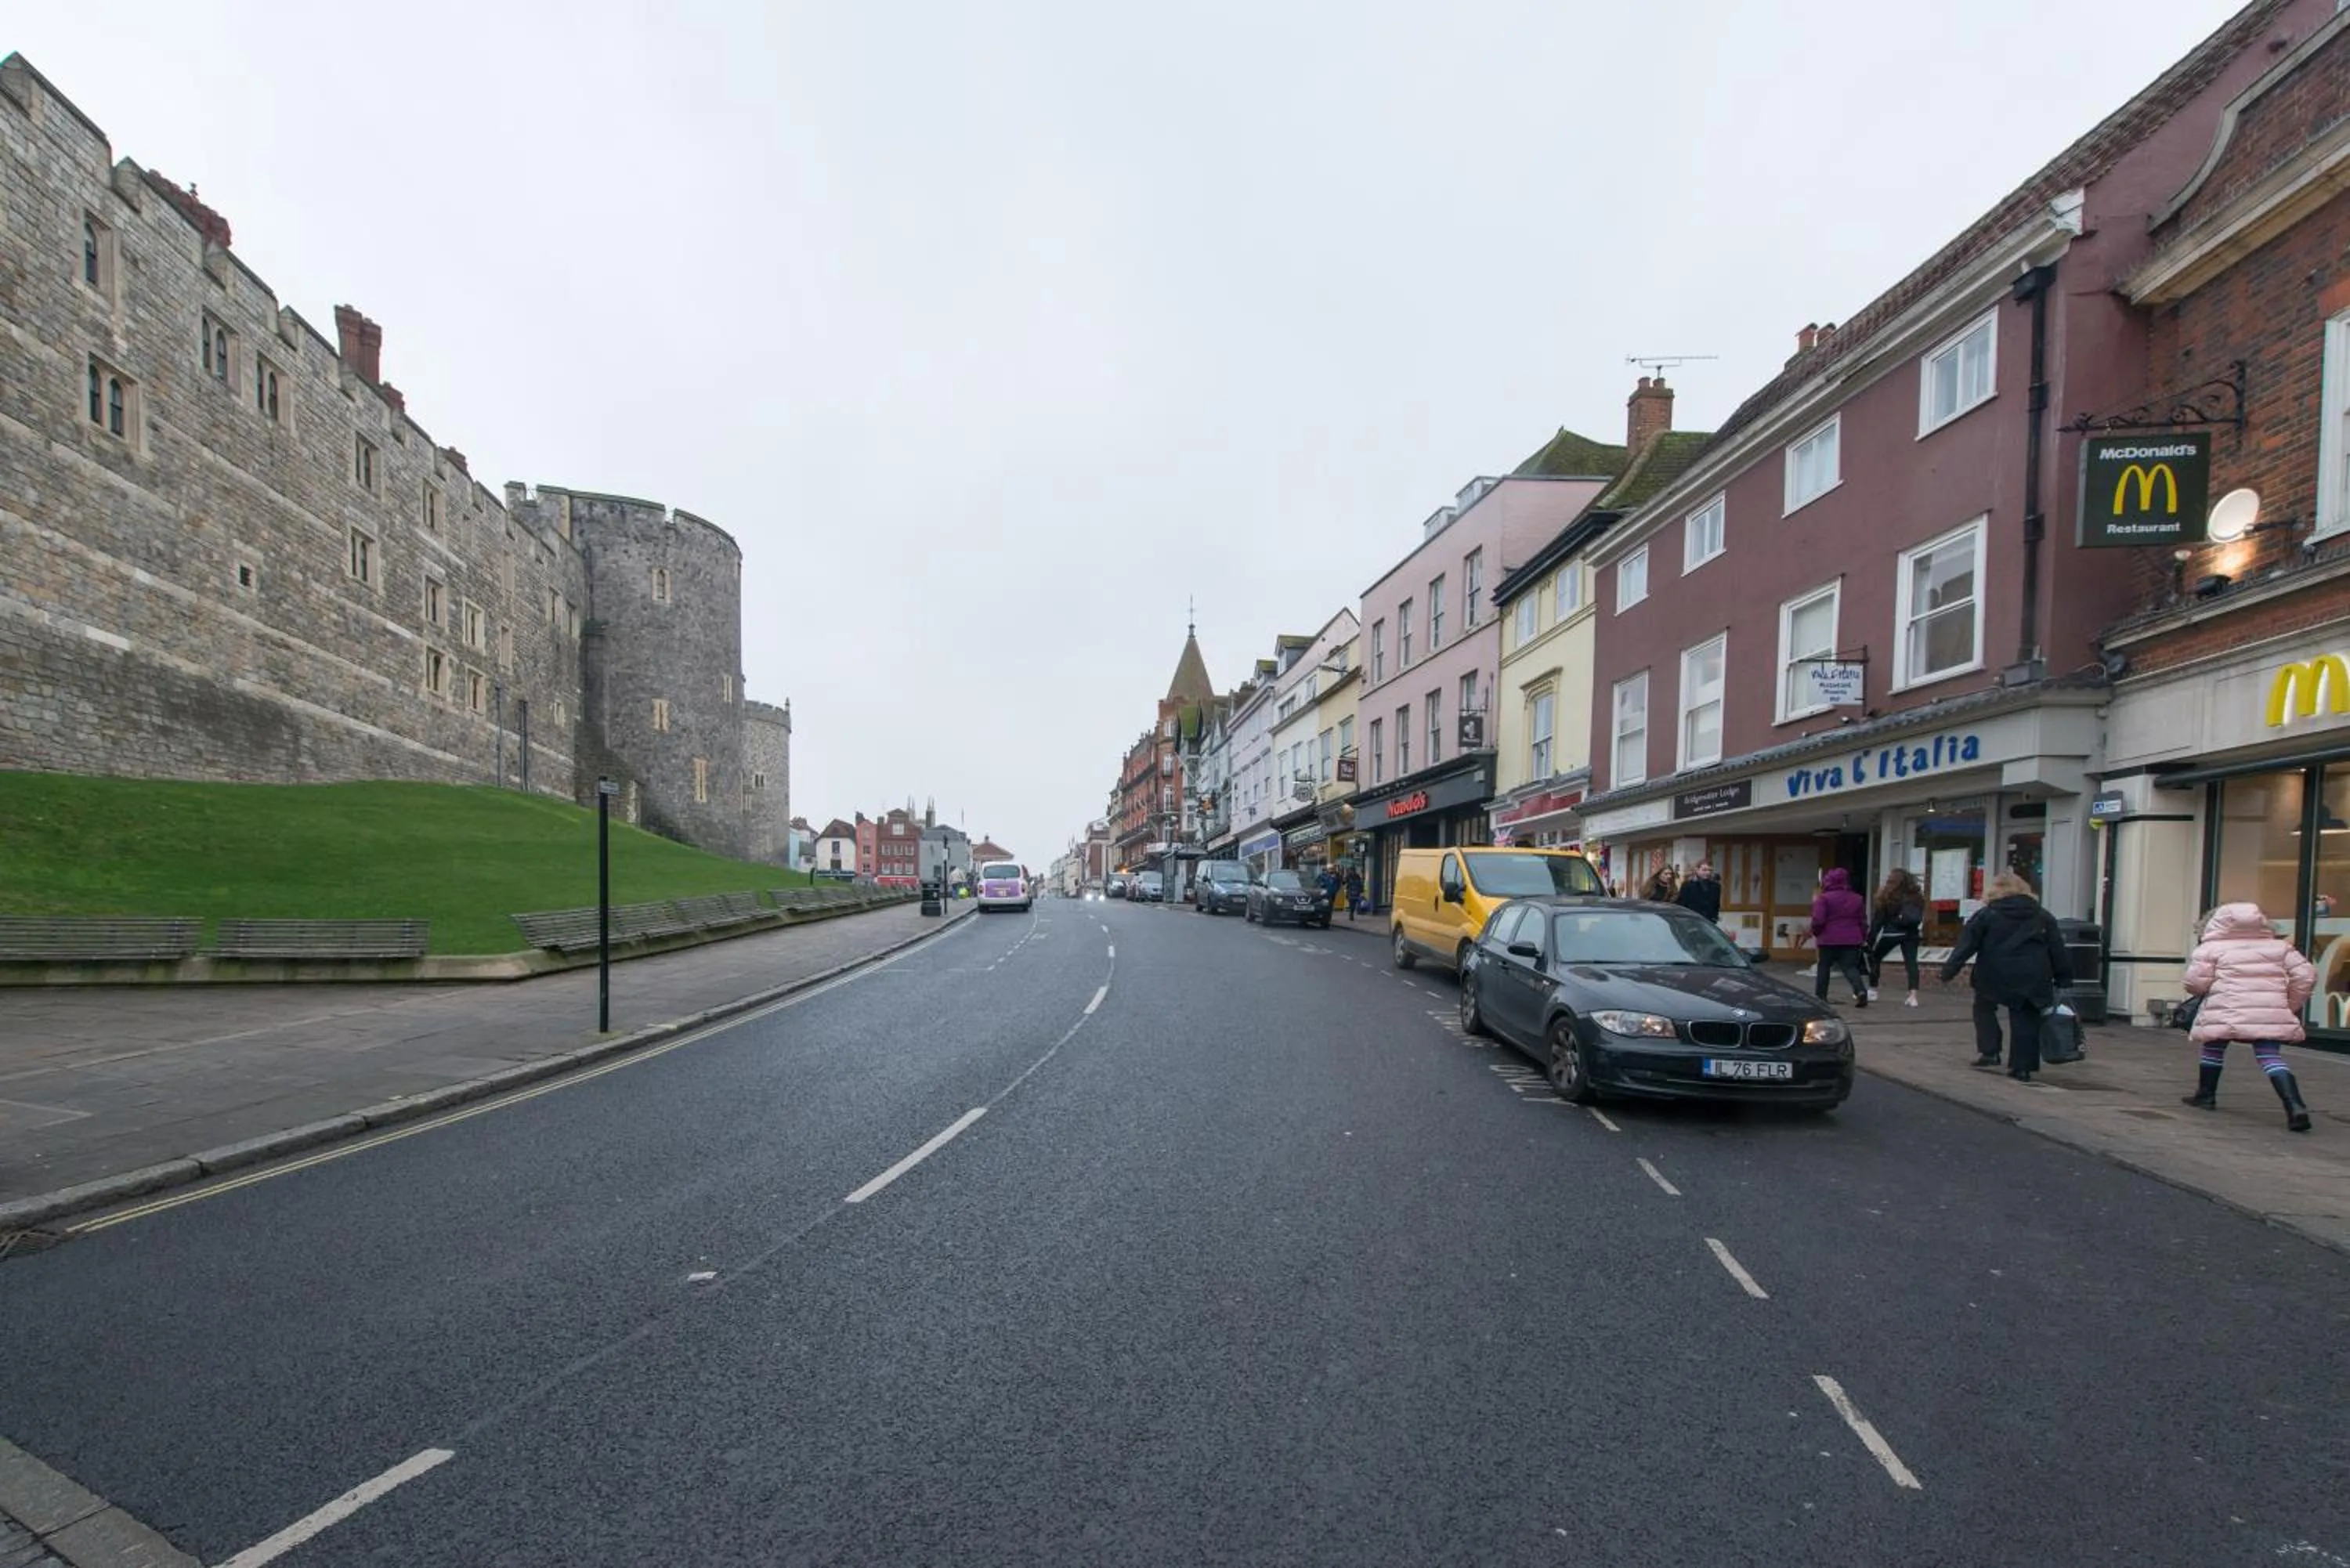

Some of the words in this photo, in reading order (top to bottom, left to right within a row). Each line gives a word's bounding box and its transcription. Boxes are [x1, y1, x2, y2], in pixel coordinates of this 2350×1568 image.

[2099, 444, 2197, 460] McDonald's
[2106, 522, 2182, 534] Restaurant
[1787, 767, 1843, 797] Viva
[1733, 1061, 1752, 1078] 76
[1757, 1063, 1788, 1078] FLR
